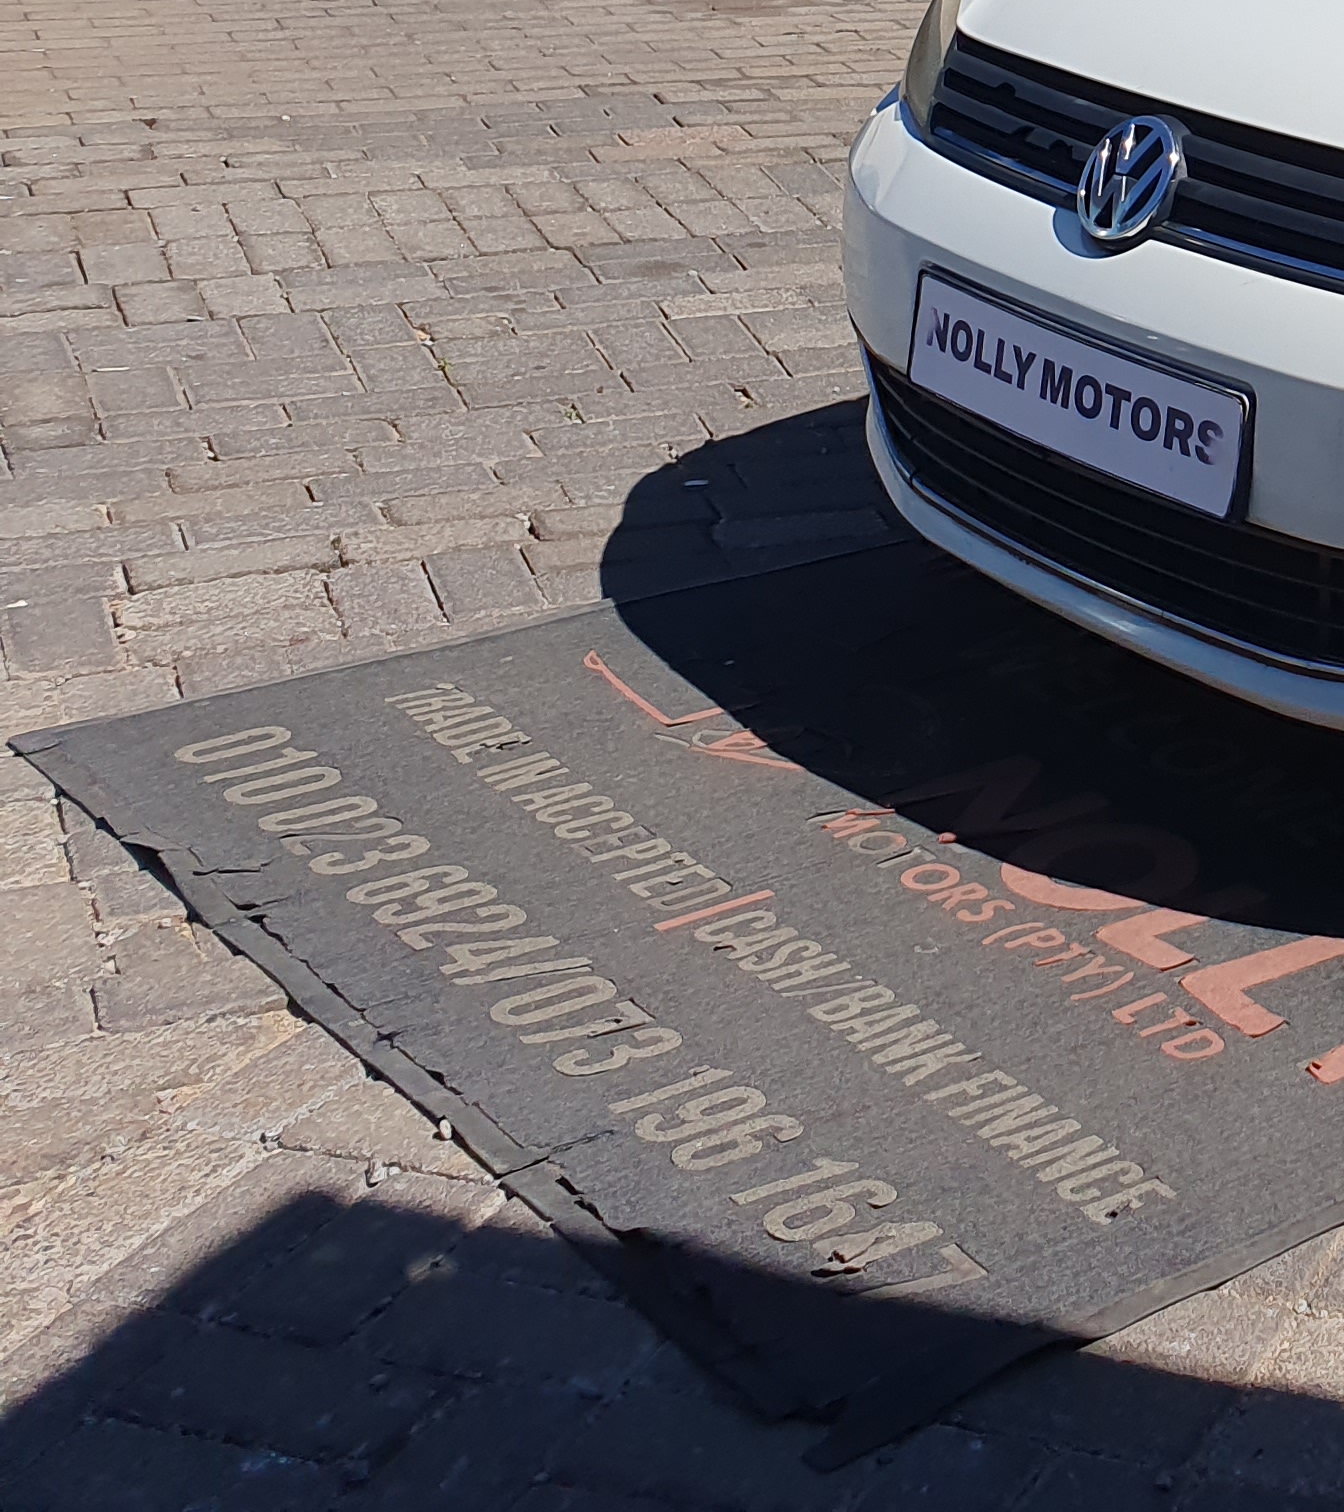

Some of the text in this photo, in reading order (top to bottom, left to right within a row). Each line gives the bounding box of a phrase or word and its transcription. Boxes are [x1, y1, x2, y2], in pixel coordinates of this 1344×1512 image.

[926, 307, 1224, 465] NOLLY MOTORS
[174, 725, 342, 805] 010
[258, 795, 431, 875] 023
[608, 1065, 804, 1171] 196
[384, 682, 532, 765] TRADE
[476, 752, 570, 791] IN
[922, 1069, 1176, 1226] FINANCE
[981, 922, 1134, 1001] (PTY)
[1112, 992, 1225, 1060] LTD
